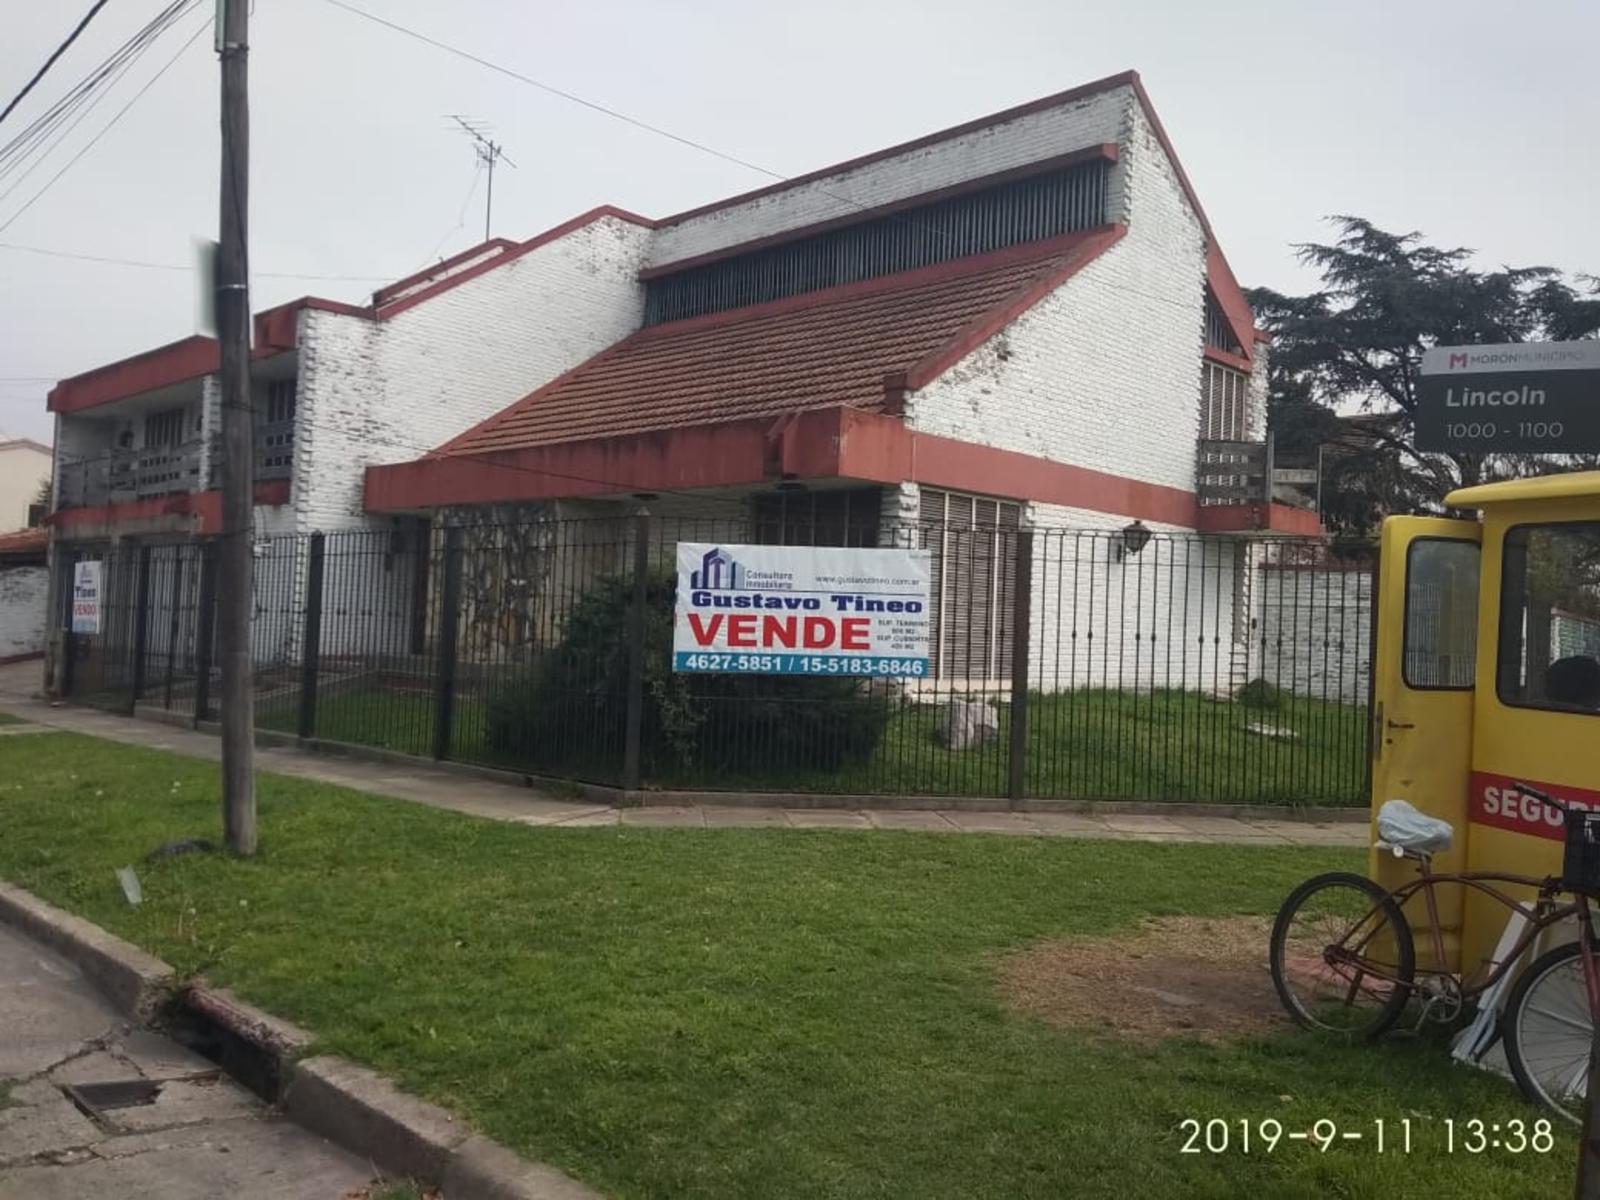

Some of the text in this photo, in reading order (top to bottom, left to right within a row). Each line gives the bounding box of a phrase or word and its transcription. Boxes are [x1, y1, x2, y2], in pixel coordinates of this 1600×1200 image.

[1447, 385, 1546, 407] Lincoln
[1446, 422, 1497, 438] 1000
[1519, 422, 1564, 438] 1100
[691, 591, 923, 613] Gustavo Tineo
[687, 613, 871, 651] VENDE
[686, 655, 923, 674] 4627-5851 / 15-5183-6846
